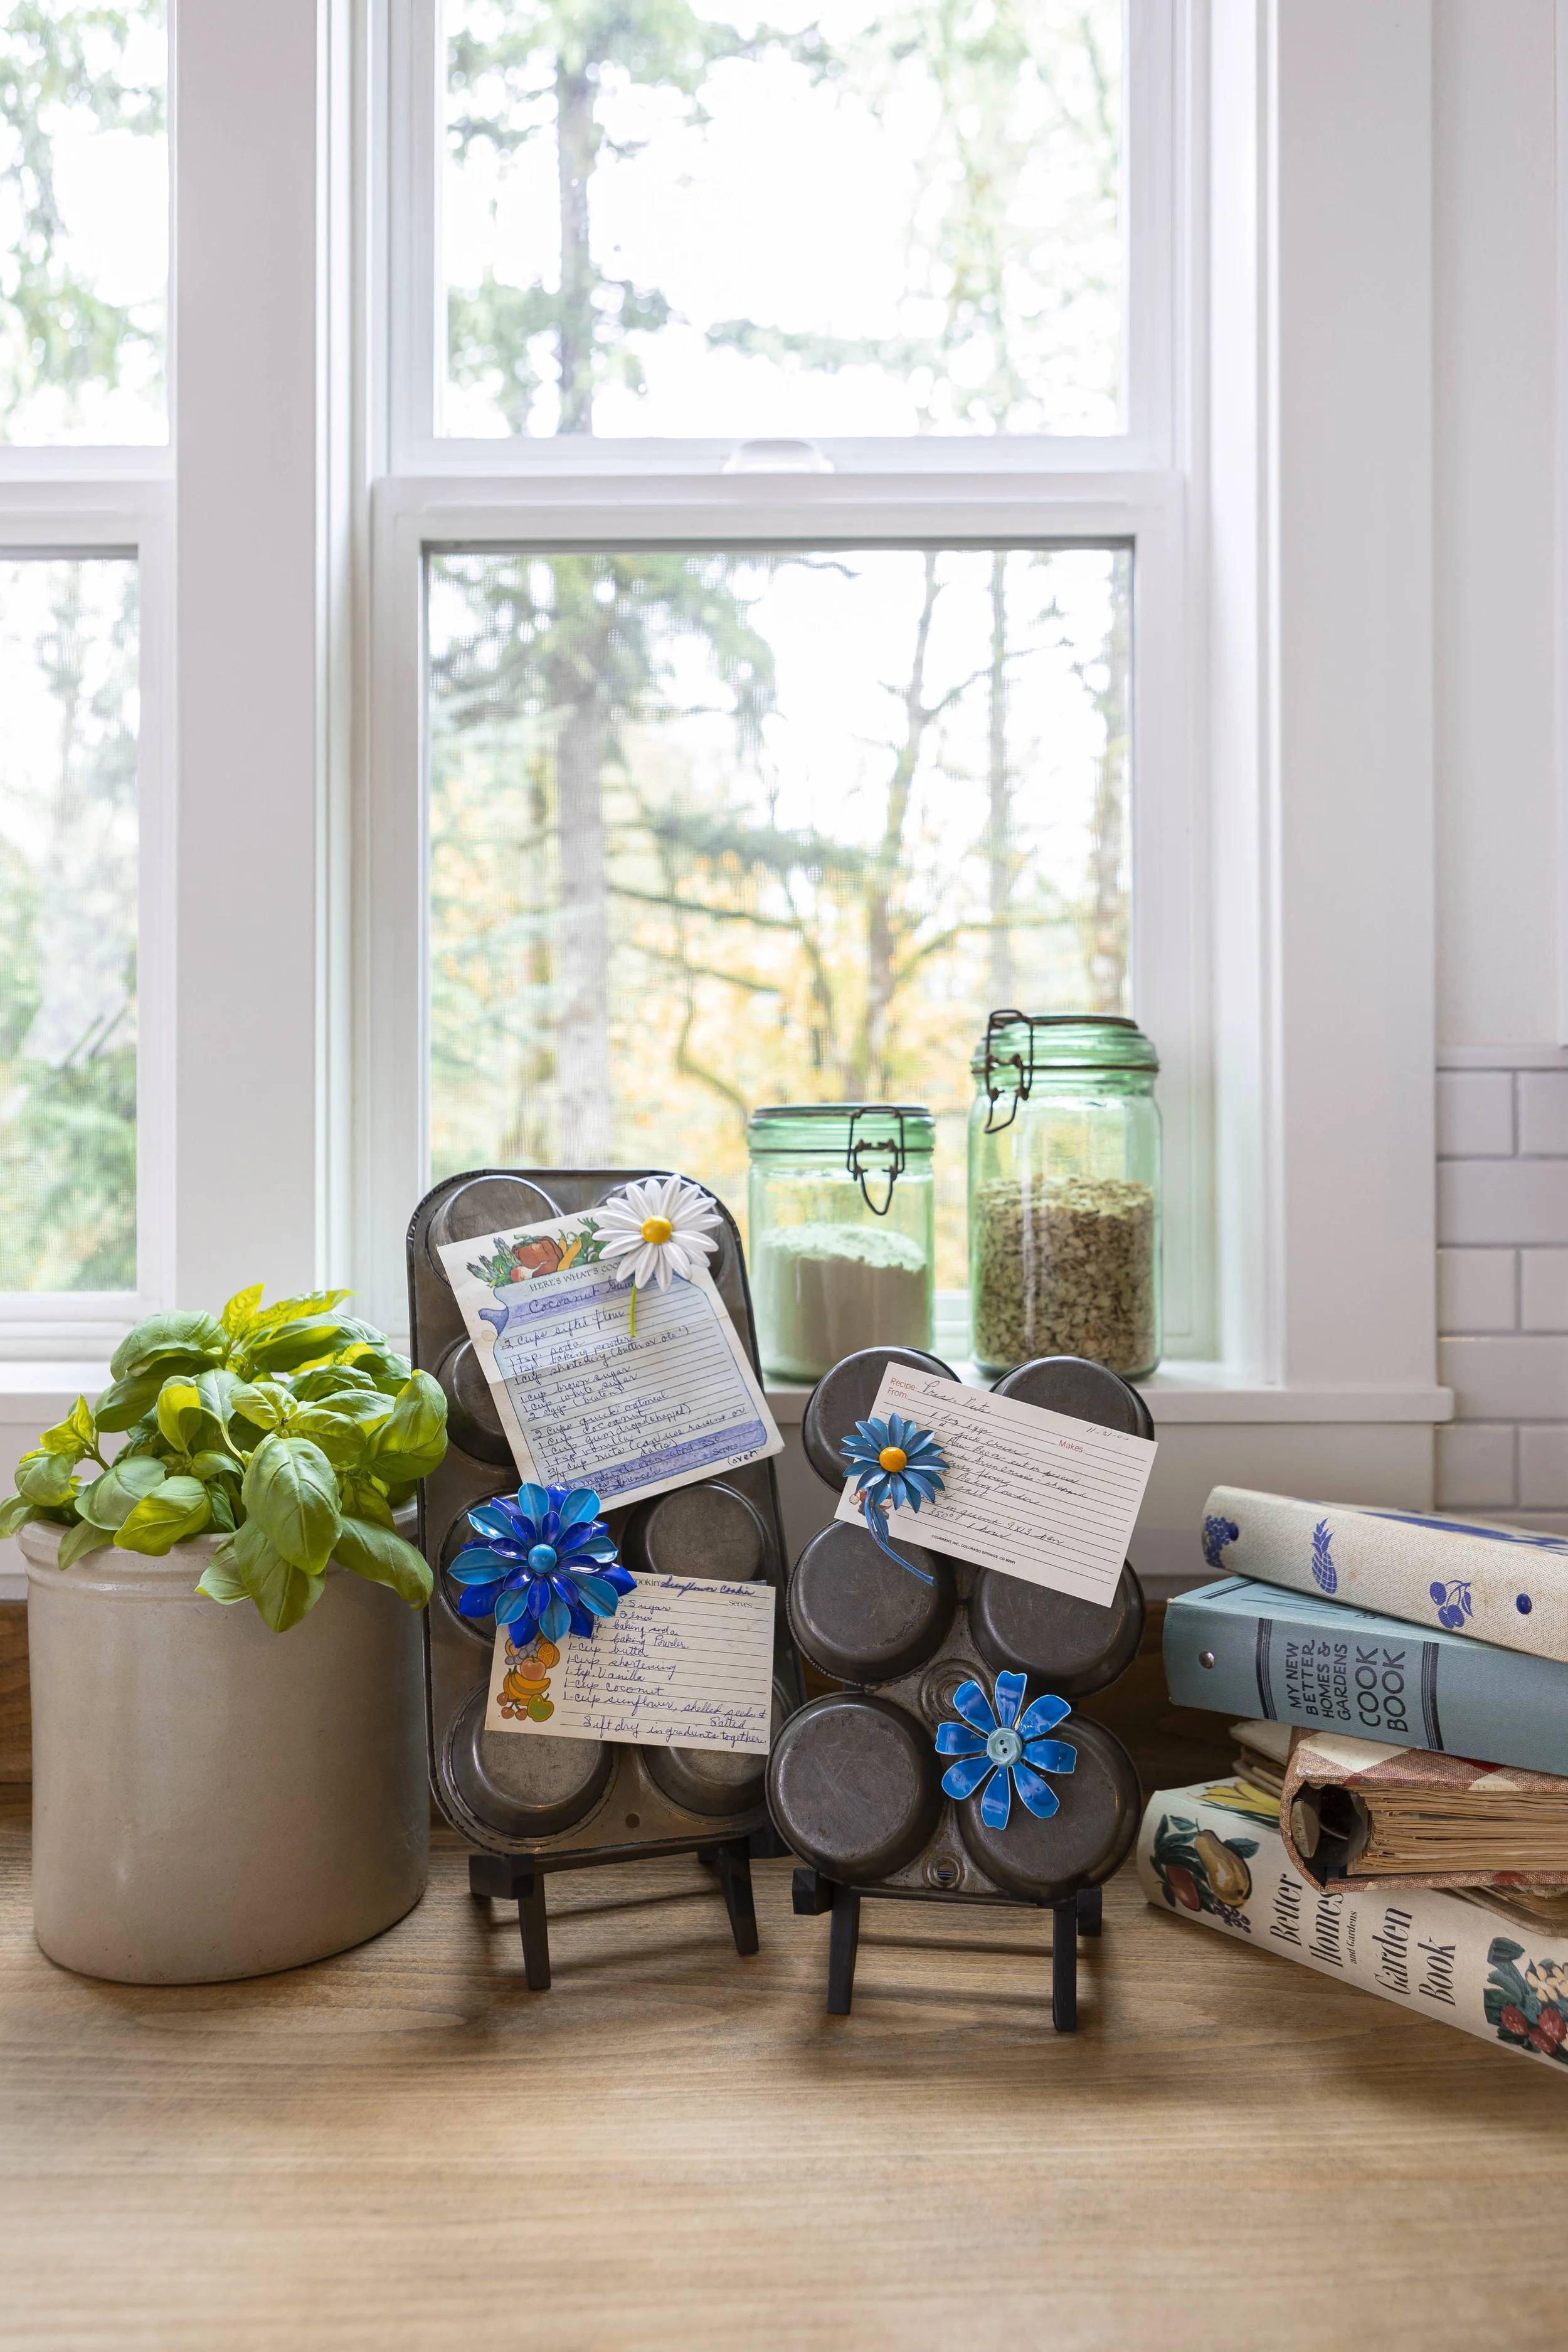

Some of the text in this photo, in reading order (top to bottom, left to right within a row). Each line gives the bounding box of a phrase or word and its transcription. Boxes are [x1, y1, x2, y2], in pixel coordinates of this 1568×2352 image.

[529, 1276, 561, 1291] HERE'S
[564, 1267, 598, 1283] WHAT'S
[502, 1337, 514, 1349] 2
[554, 1319, 587, 1337] sifted
[550, 1340, 585, 1355] soda
[550, 1348, 588, 1365] baking
[594, 1366, 630, 1382] sugar
[890, 1377, 918, 1392] Recipe:
[887, 1387, 908, 1400] From:
[1058, 1439, 1086, 1454] Makes:
[961, 1544, 981, 1554] COLORADO
[628, 1599, 671, 1614] Sugar
[610, 1632, 645, 1650] baking
[612, 1619, 646, 1639] baking
[1286, 1641, 1302, 1708] MY NEW
[1301, 1640, 1319, 1715] BETTER
[1317, 1641, 1335, 1719] HOMES &
[1333, 1643, 1352, 1720] GARDENS
[1355, 1645, 1381, 1727] COOK
[1382, 1648, 1409, 1732] BOOK
[615, 1718, 639, 1739] dry
[1269, 1873, 1303, 1947] Better
[1308, 1891, 1344, 1968] Homes
[1346, 1910, 1358, 1965] and Gardens
[1372, 1907, 1413, 1994] Garden
[1417, 1936, 1456, 2006] Book
